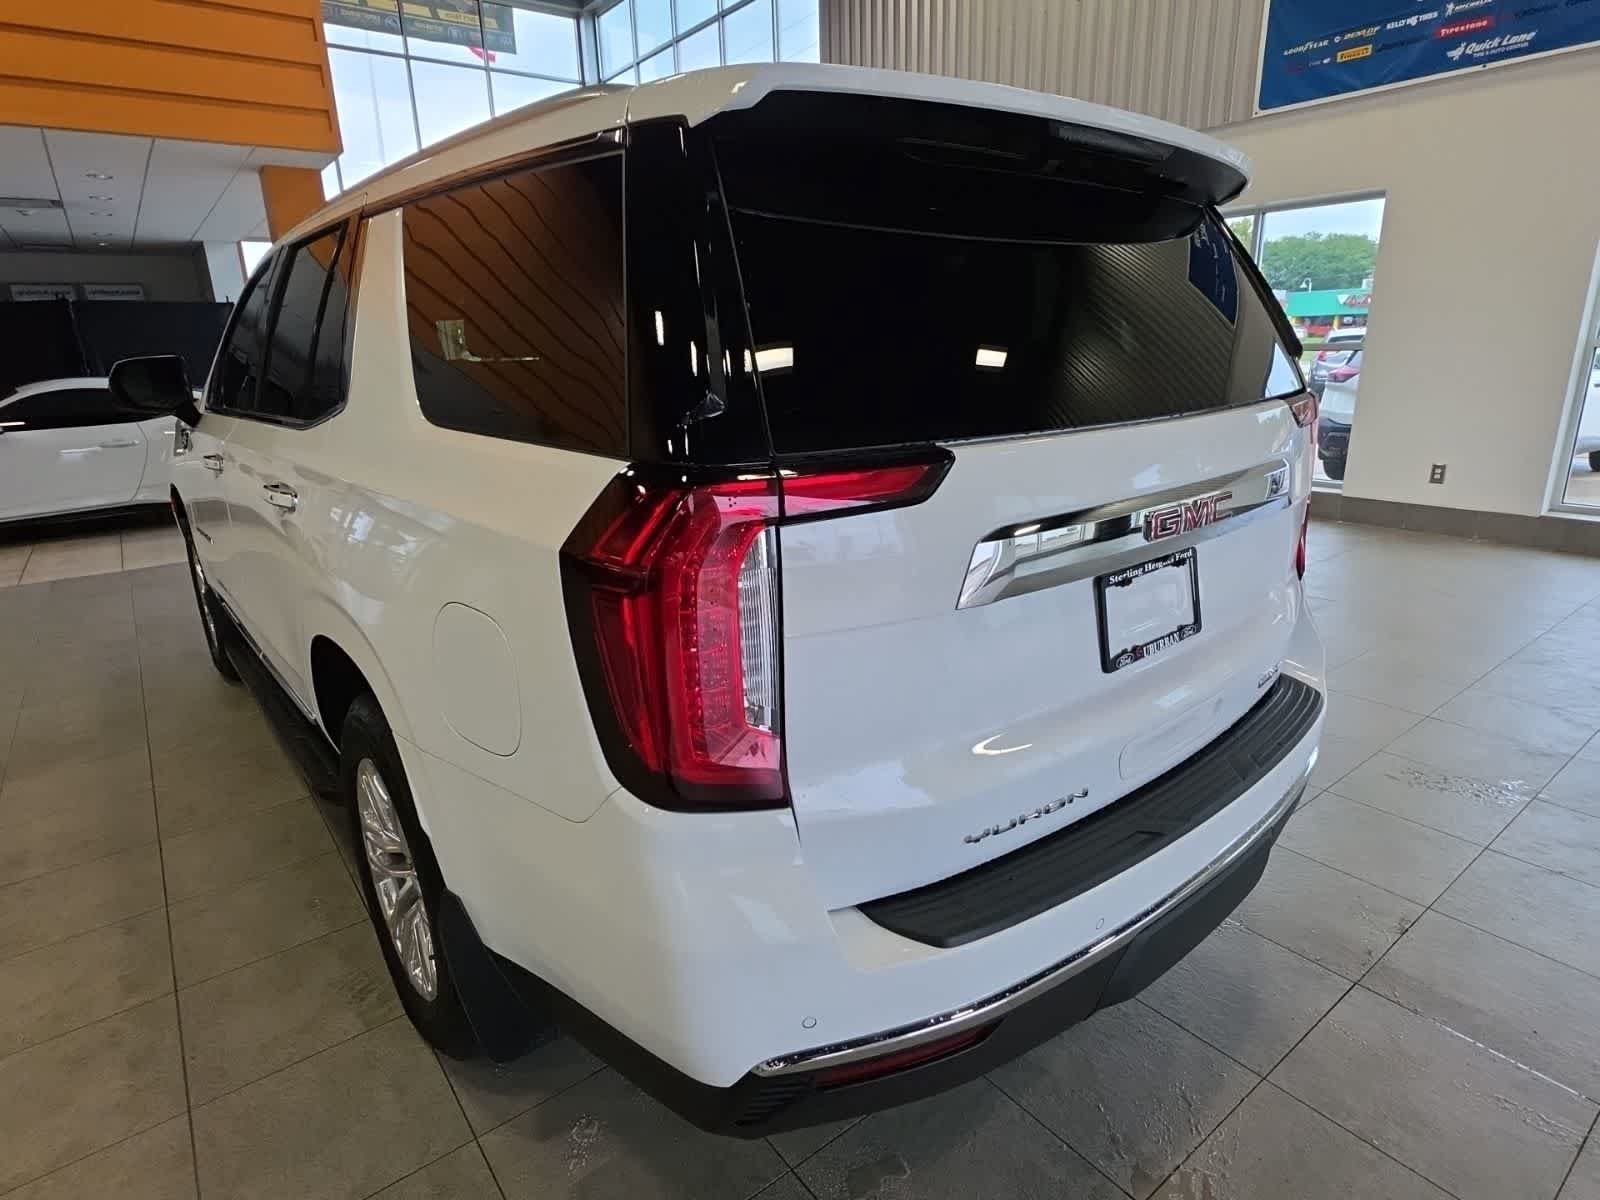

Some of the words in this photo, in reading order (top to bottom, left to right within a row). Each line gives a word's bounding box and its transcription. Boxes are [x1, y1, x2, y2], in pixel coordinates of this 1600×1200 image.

[1441, 20, 1488, 37] Firestone
[1283, 40, 1329, 55] GOODYEAR
[1465, 38, 1501, 54] Quick
[1501, 33, 1536, 46] Lane
[1148, 491, 1233, 541] GMC
[1109, 569, 1143, 584] Sterling
[1175, 549, 1193, 561] Ford
